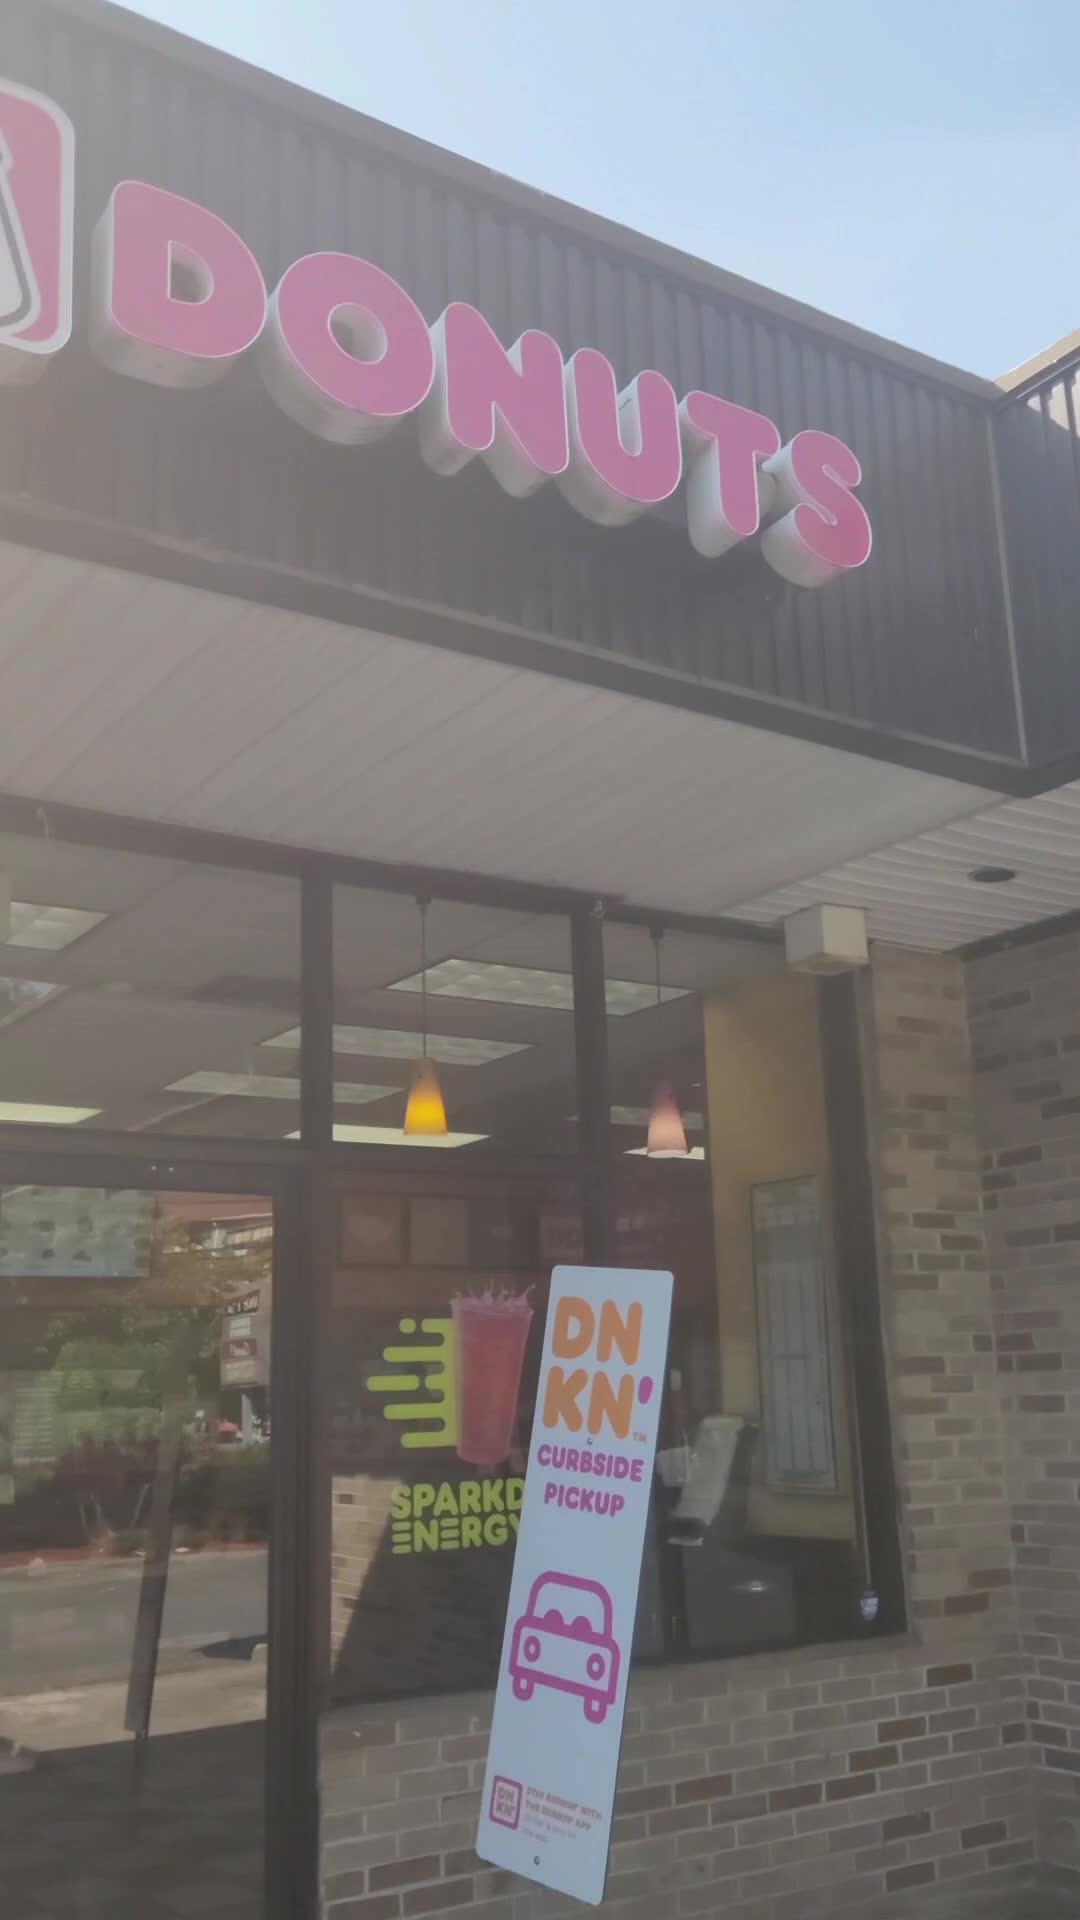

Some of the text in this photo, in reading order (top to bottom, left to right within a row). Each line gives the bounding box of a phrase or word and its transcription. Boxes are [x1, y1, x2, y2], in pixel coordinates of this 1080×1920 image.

[108, 180, 874, 570] DONUTS
[551, 1295, 643, 1365] DN
[542, 1366, 653, 1439] KN'
[537, 1444, 645, 1482] CURBSIDE
[391, 1478, 526, 1519] SPARKD
[544, 1481, 625, 1518] PICKUP
